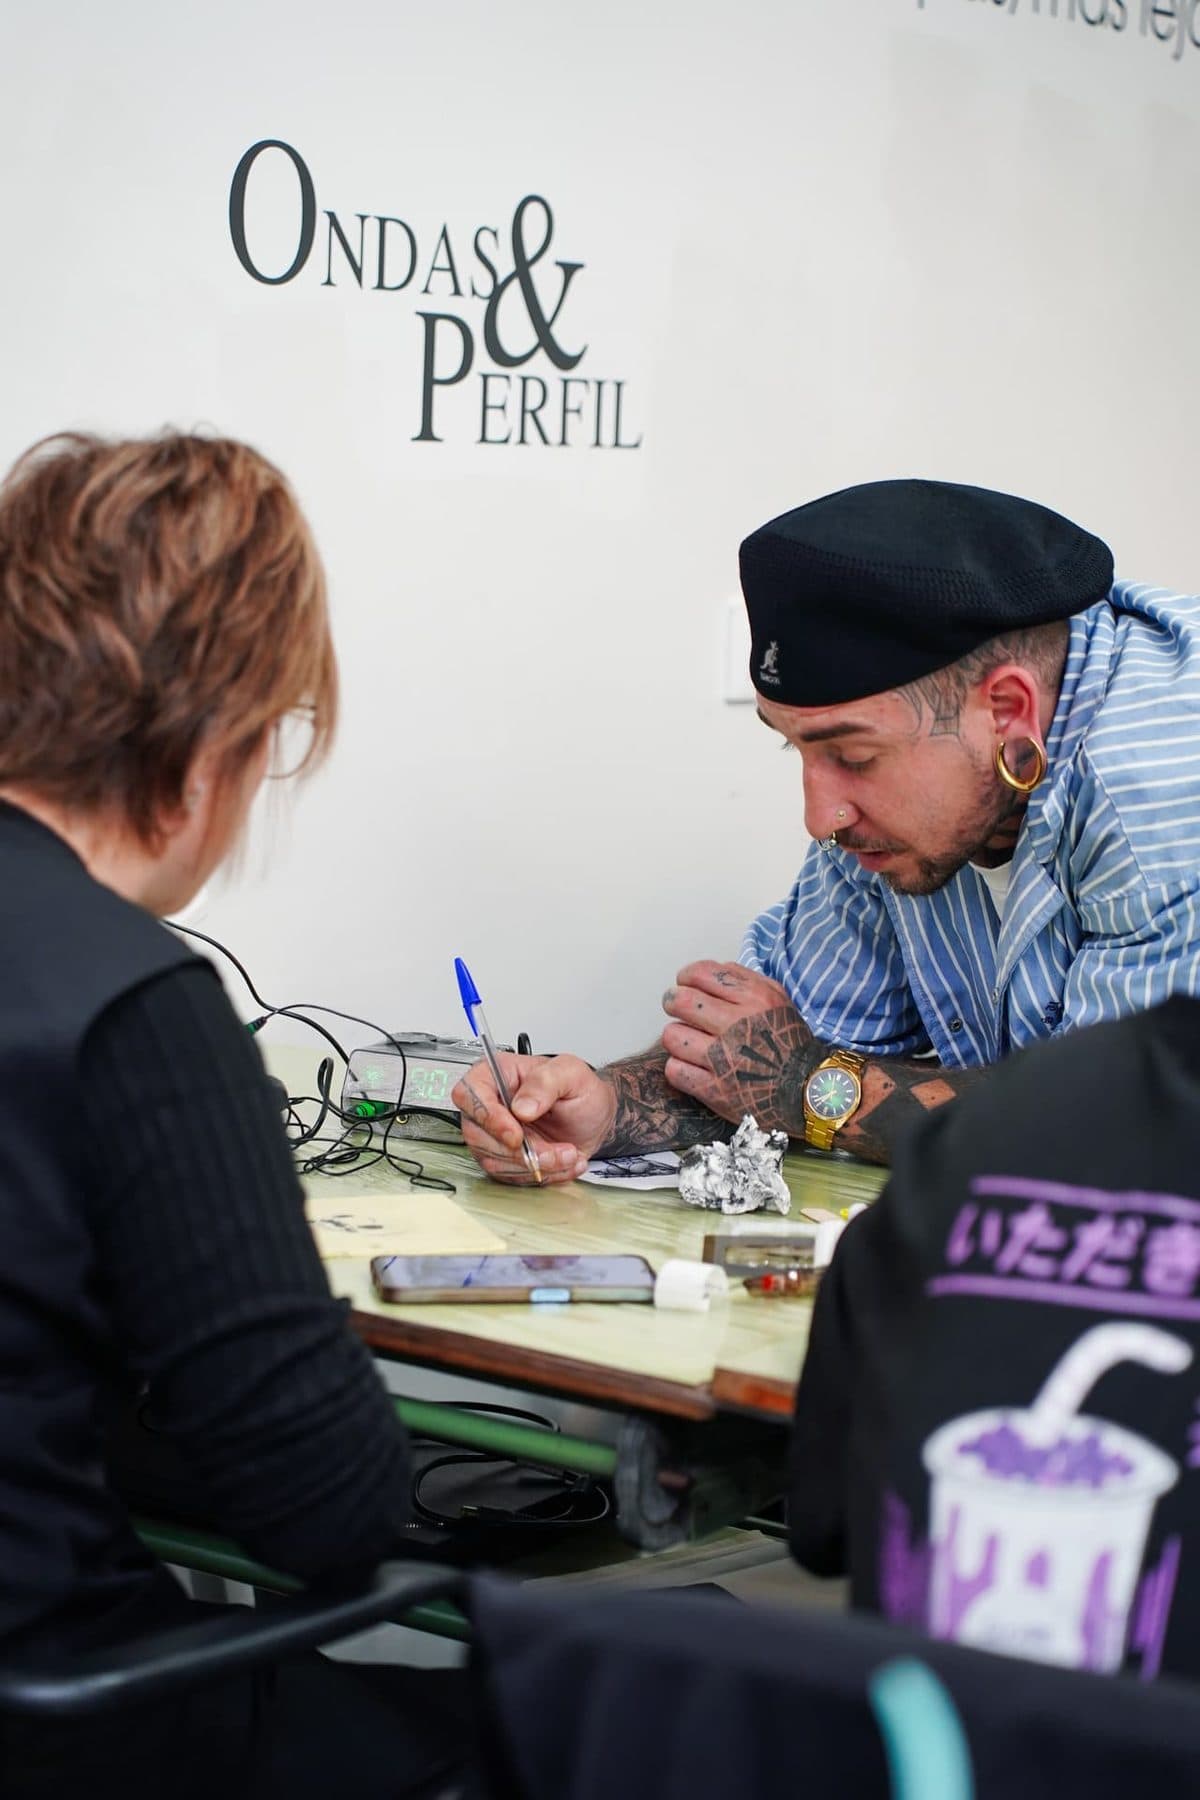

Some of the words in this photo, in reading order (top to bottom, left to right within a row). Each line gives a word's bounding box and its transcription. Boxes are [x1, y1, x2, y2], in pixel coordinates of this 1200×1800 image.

[229, 139, 498, 301] ONDAS
[483, 194, 589, 372] &
[411, 311, 644, 449] PERFIL
